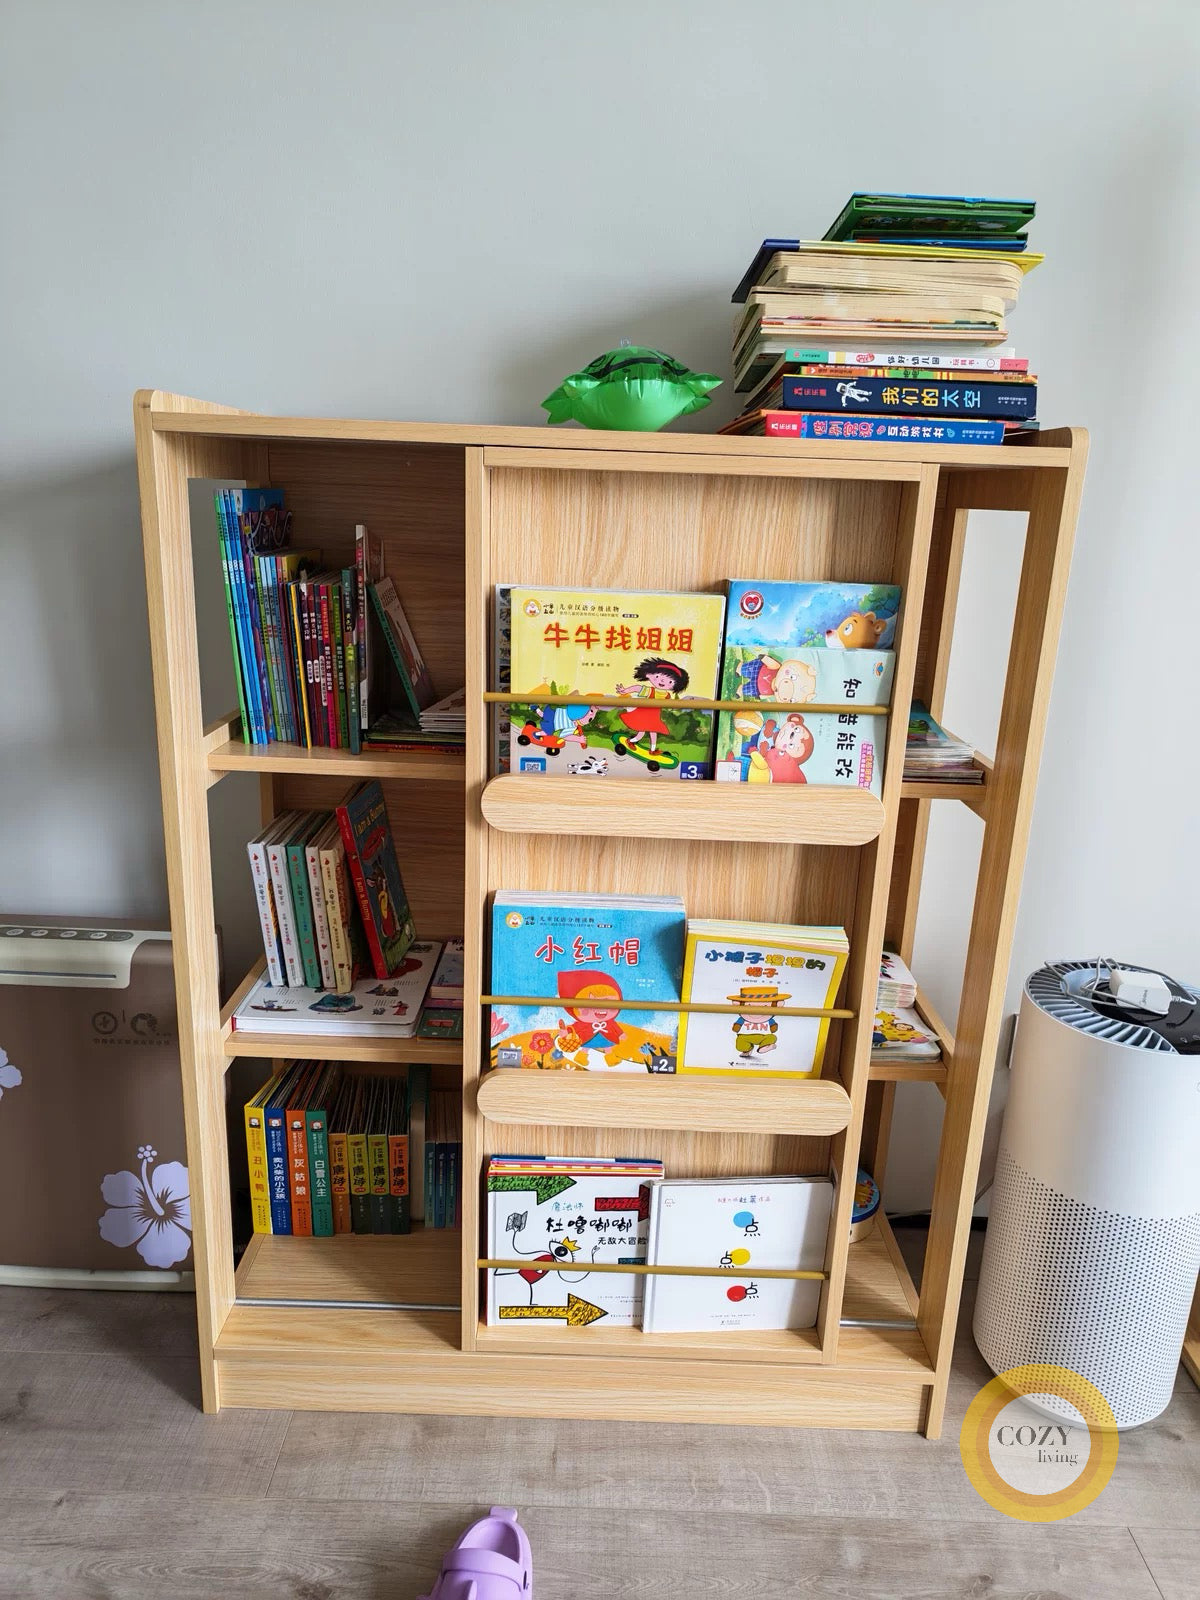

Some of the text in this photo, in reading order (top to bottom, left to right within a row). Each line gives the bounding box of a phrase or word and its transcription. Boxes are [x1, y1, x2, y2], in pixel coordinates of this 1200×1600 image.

[881, 386, 981, 409] 我们的太空
[813, 420, 874, 438] 性别常识
[887, 425, 945, 438] 互动游戏书
[559, 604, 619, 612] 儿童汉语分级读物
[543, 622, 694, 653] 牛牛找姐姐
[535, 935, 640, 966] 小红帽
[746, 966, 779, 978] 帽子
[744, 1023, 769, 1031] TAN
[253, 1156, 265, 1192] 丑小鸭
[272, 1157, 286, 1200] 卖火柴的小女孩
[294, 1158, 306, 1195] 灰姑娘
[314, 1160, 327, 1197] 白雪公主
[546, 1215, 633, 1234] 杜噜嘟嘟
[744, 1218, 761, 1237] 点
[719, 1251, 735, 1268] 点
[745, 1281, 760, 1299] 点
